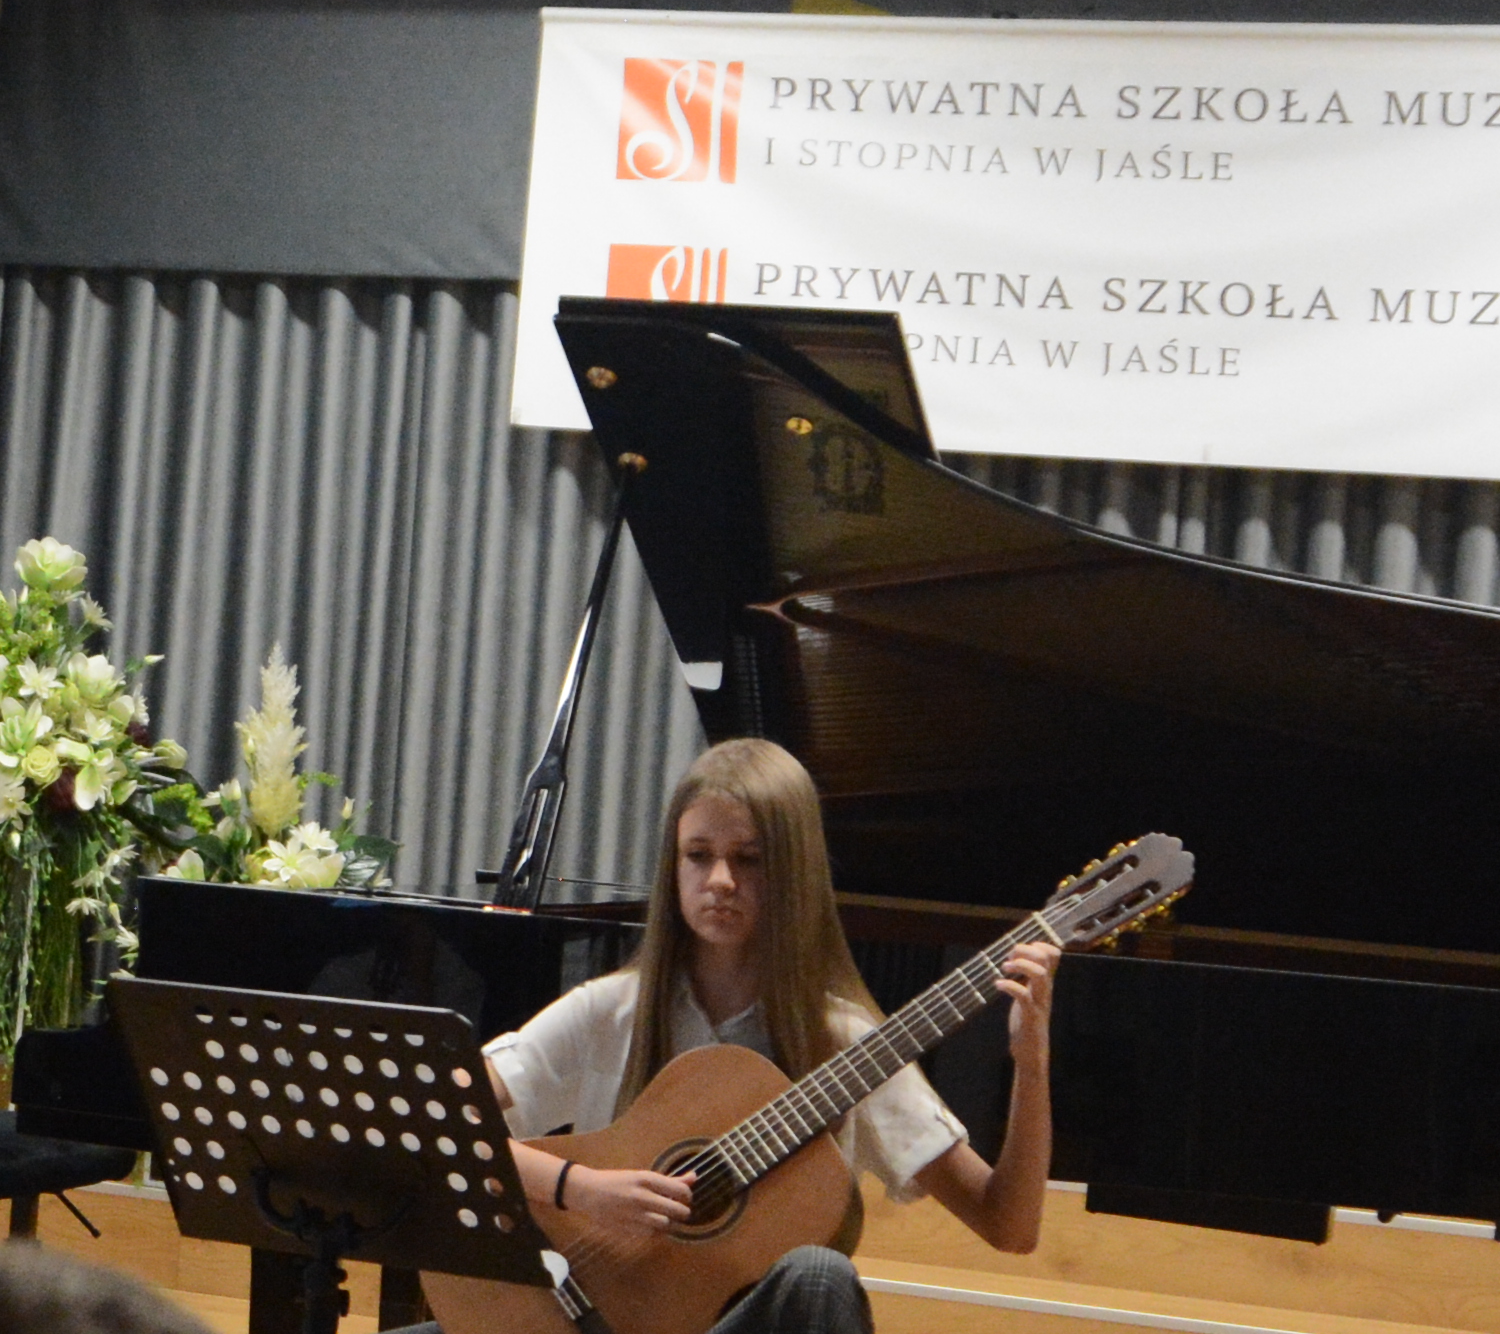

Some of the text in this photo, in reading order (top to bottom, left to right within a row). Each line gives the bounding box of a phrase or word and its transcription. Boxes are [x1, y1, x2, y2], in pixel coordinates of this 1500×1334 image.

[768, 75, 1088, 120] PRYWATNA
[1115, 83, 1354, 126] SZKOŁA
[764, 136, 1236, 182] I STOPNIA W JAŚLE
[752, 262, 1073, 312] PRYWATNA
[1101, 277, 1340, 323] SZKOŁA
[904, 332, 1242, 379] PNIA W JAŚLE
